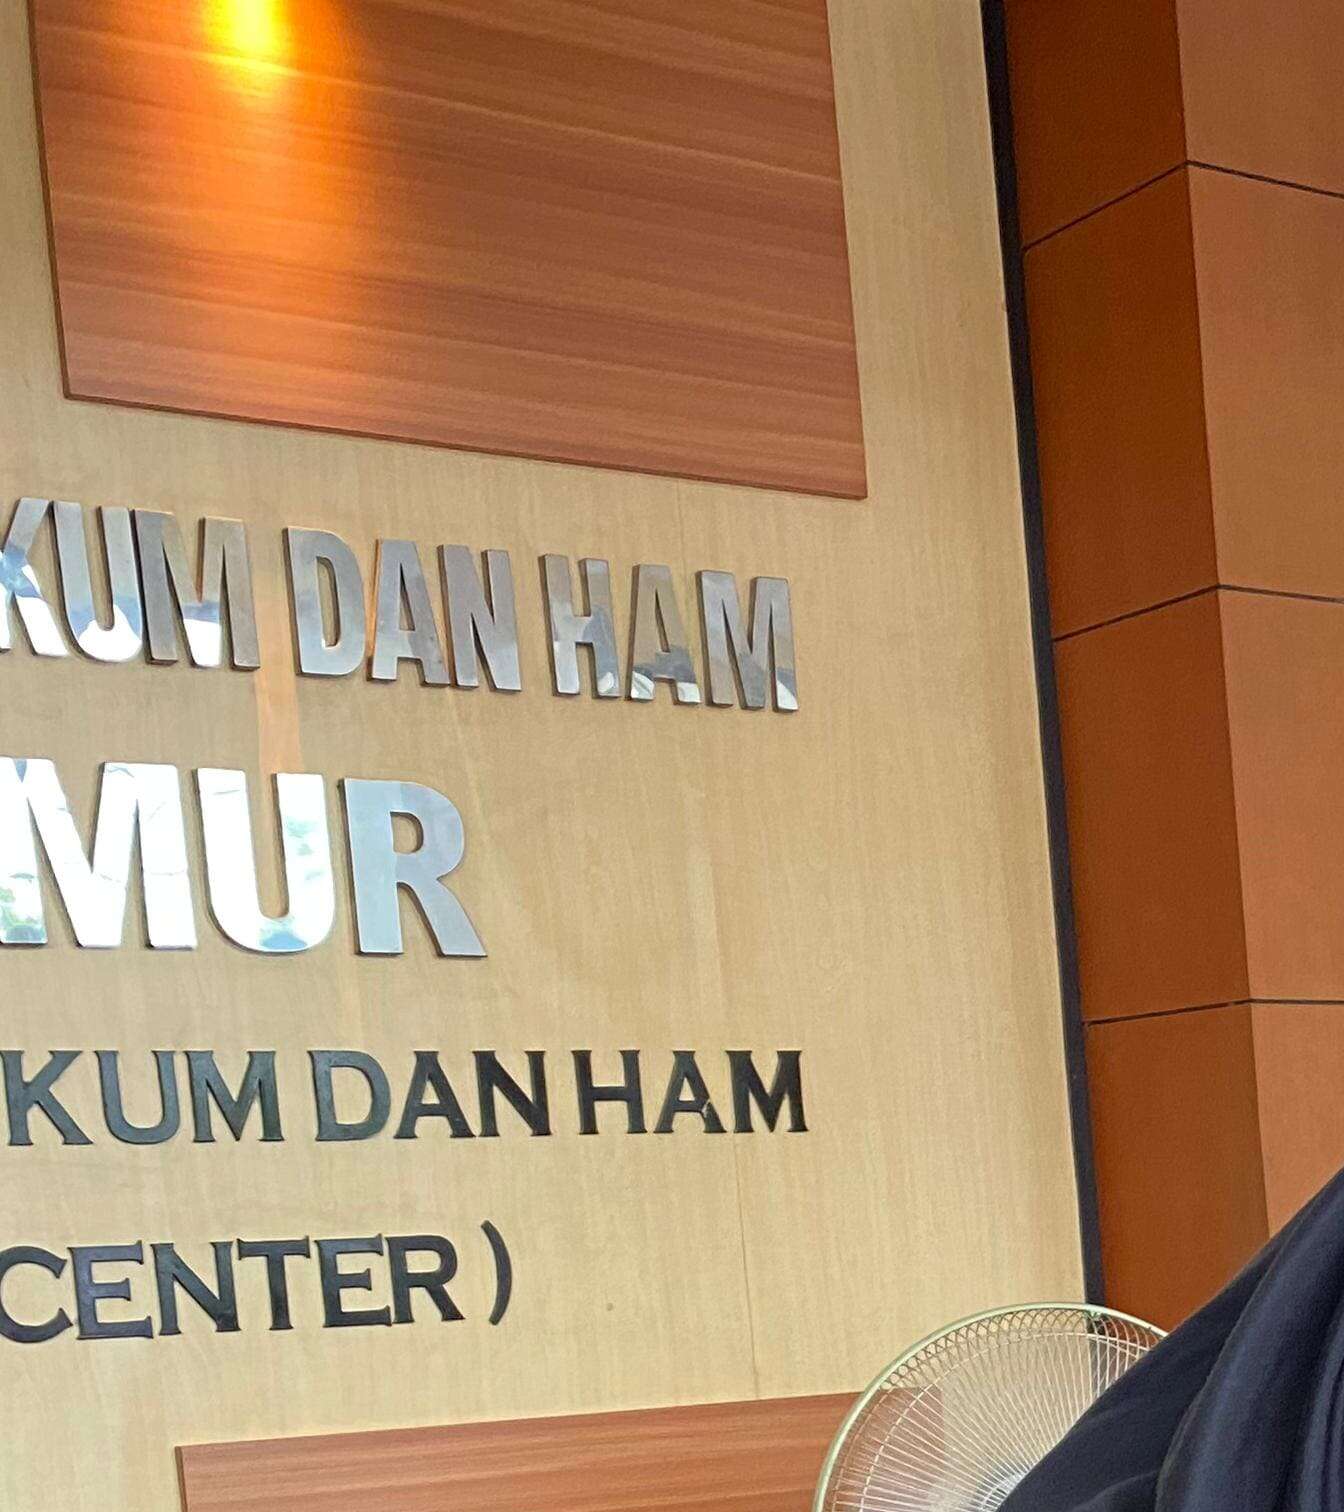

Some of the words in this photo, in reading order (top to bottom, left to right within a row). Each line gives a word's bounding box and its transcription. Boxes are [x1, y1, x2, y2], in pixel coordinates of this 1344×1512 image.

[0, 496, 260, 671] KUM
[286, 524, 522, 693] DAN
[540, 552, 800, 712] HAM
[0, 756, 488, 959] MUR
[2, 1049, 285, 1146] KUM
[310, 1050, 551, 1142] DAN
[573, 1048, 809, 1135] HAM
